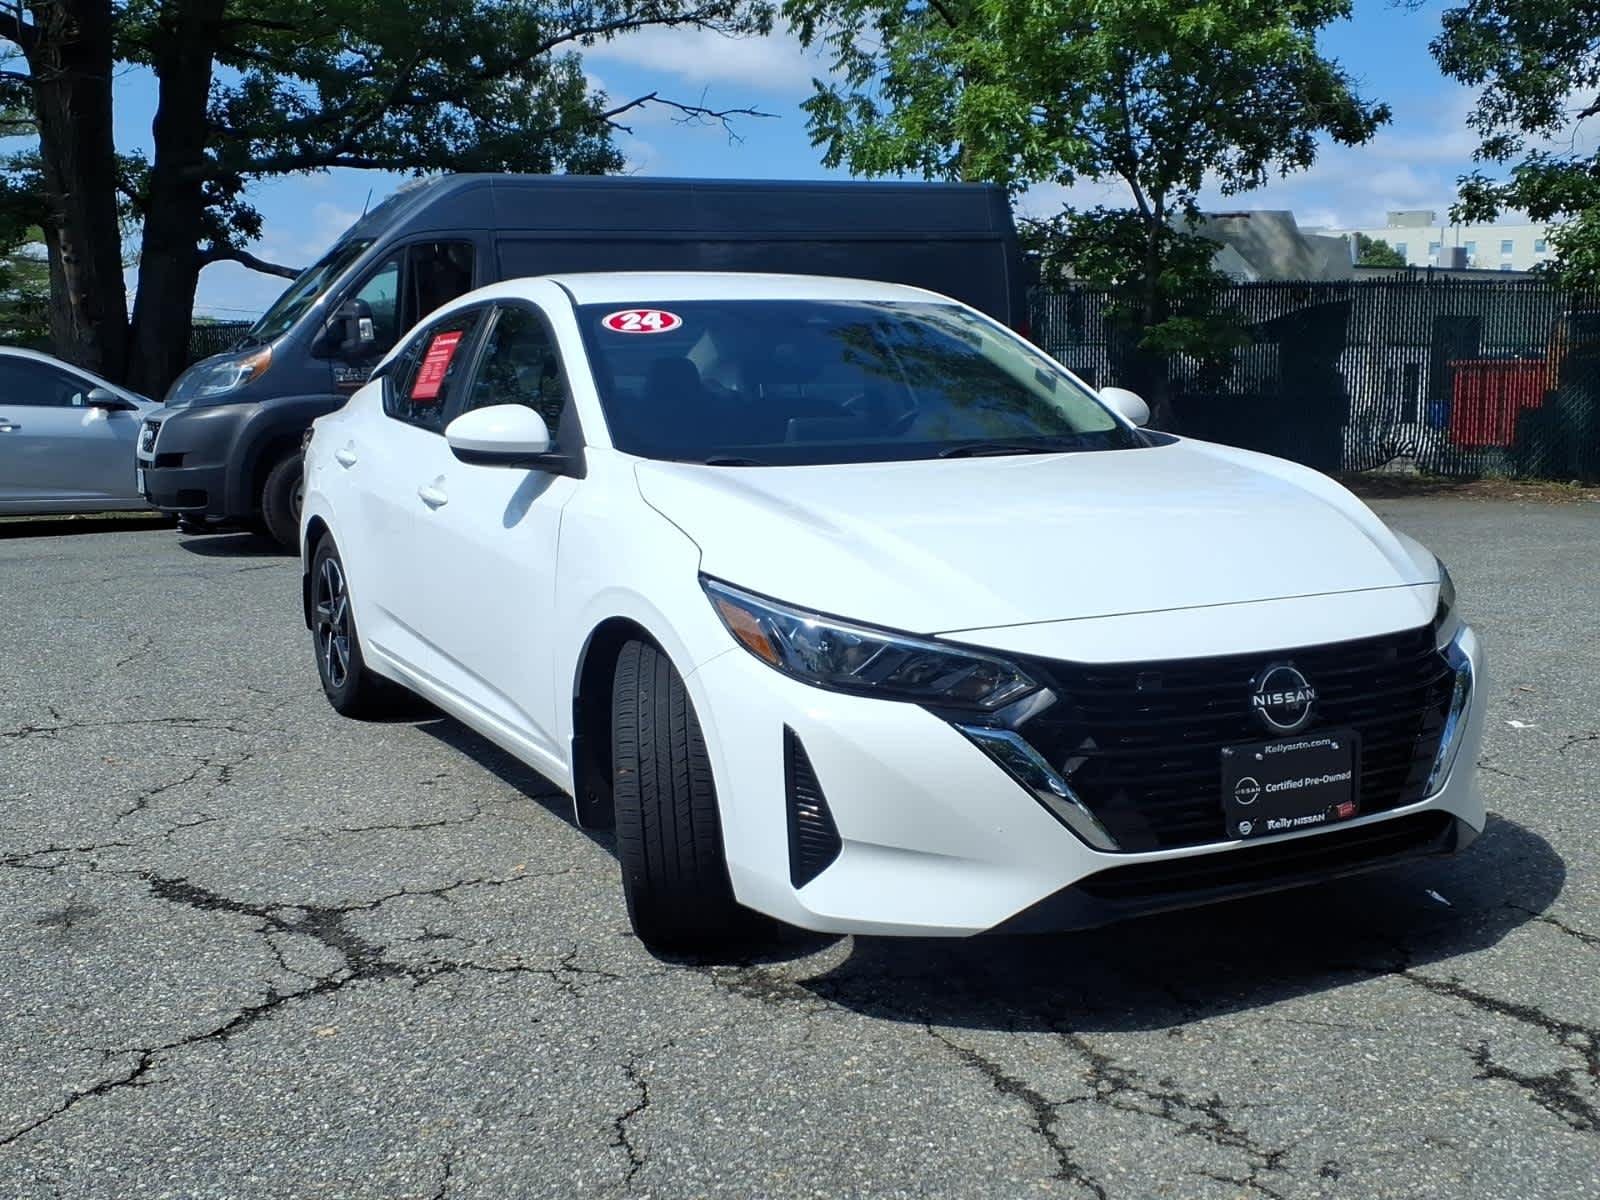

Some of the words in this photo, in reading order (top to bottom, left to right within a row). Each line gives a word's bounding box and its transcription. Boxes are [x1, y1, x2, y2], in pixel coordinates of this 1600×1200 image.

[620, 312, 664, 330] 24
[1253, 688, 1315, 706] NISSAN
[1265, 739, 1331, 753] Kellyauto.com
[1265, 778, 1303, 792] Certified
[1304, 770, 1351, 786] Pre-Owned
[1294, 813, 1325, 826] NISSAN
